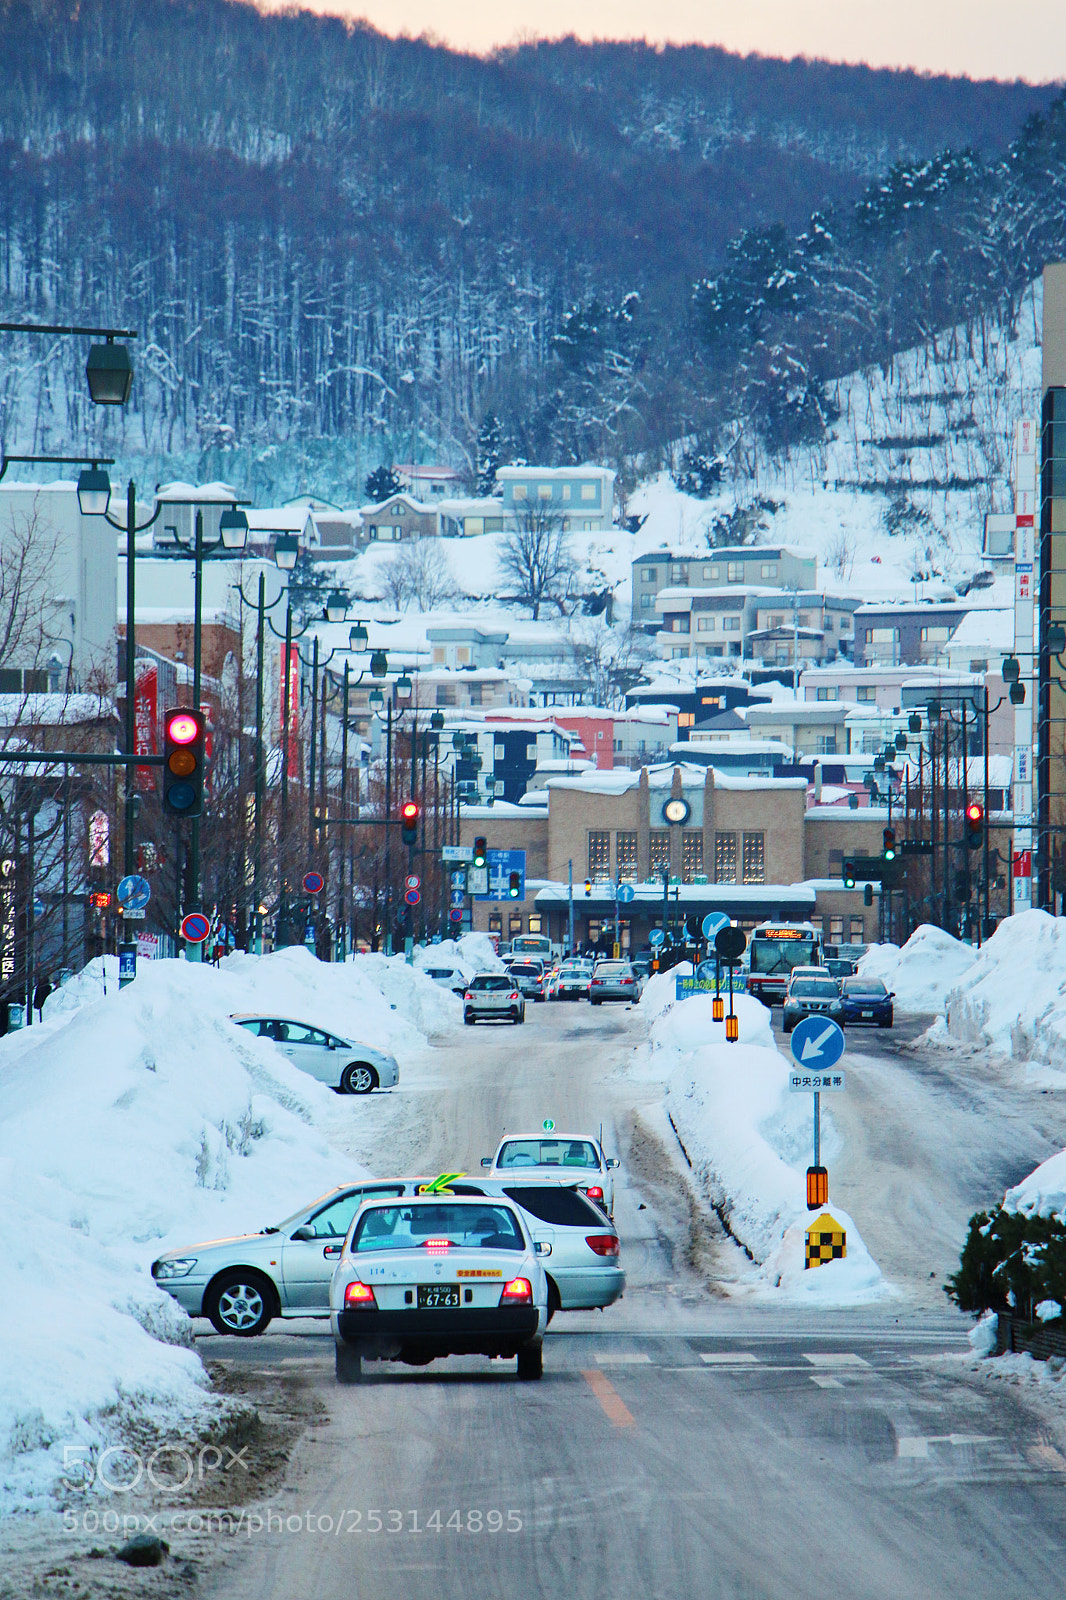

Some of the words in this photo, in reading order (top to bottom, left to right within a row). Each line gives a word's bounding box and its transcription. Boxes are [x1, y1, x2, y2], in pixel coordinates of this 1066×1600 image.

[792, 1076, 842, 1087] 中央分離帯
[426, 1293, 458, 1306] 67-63
